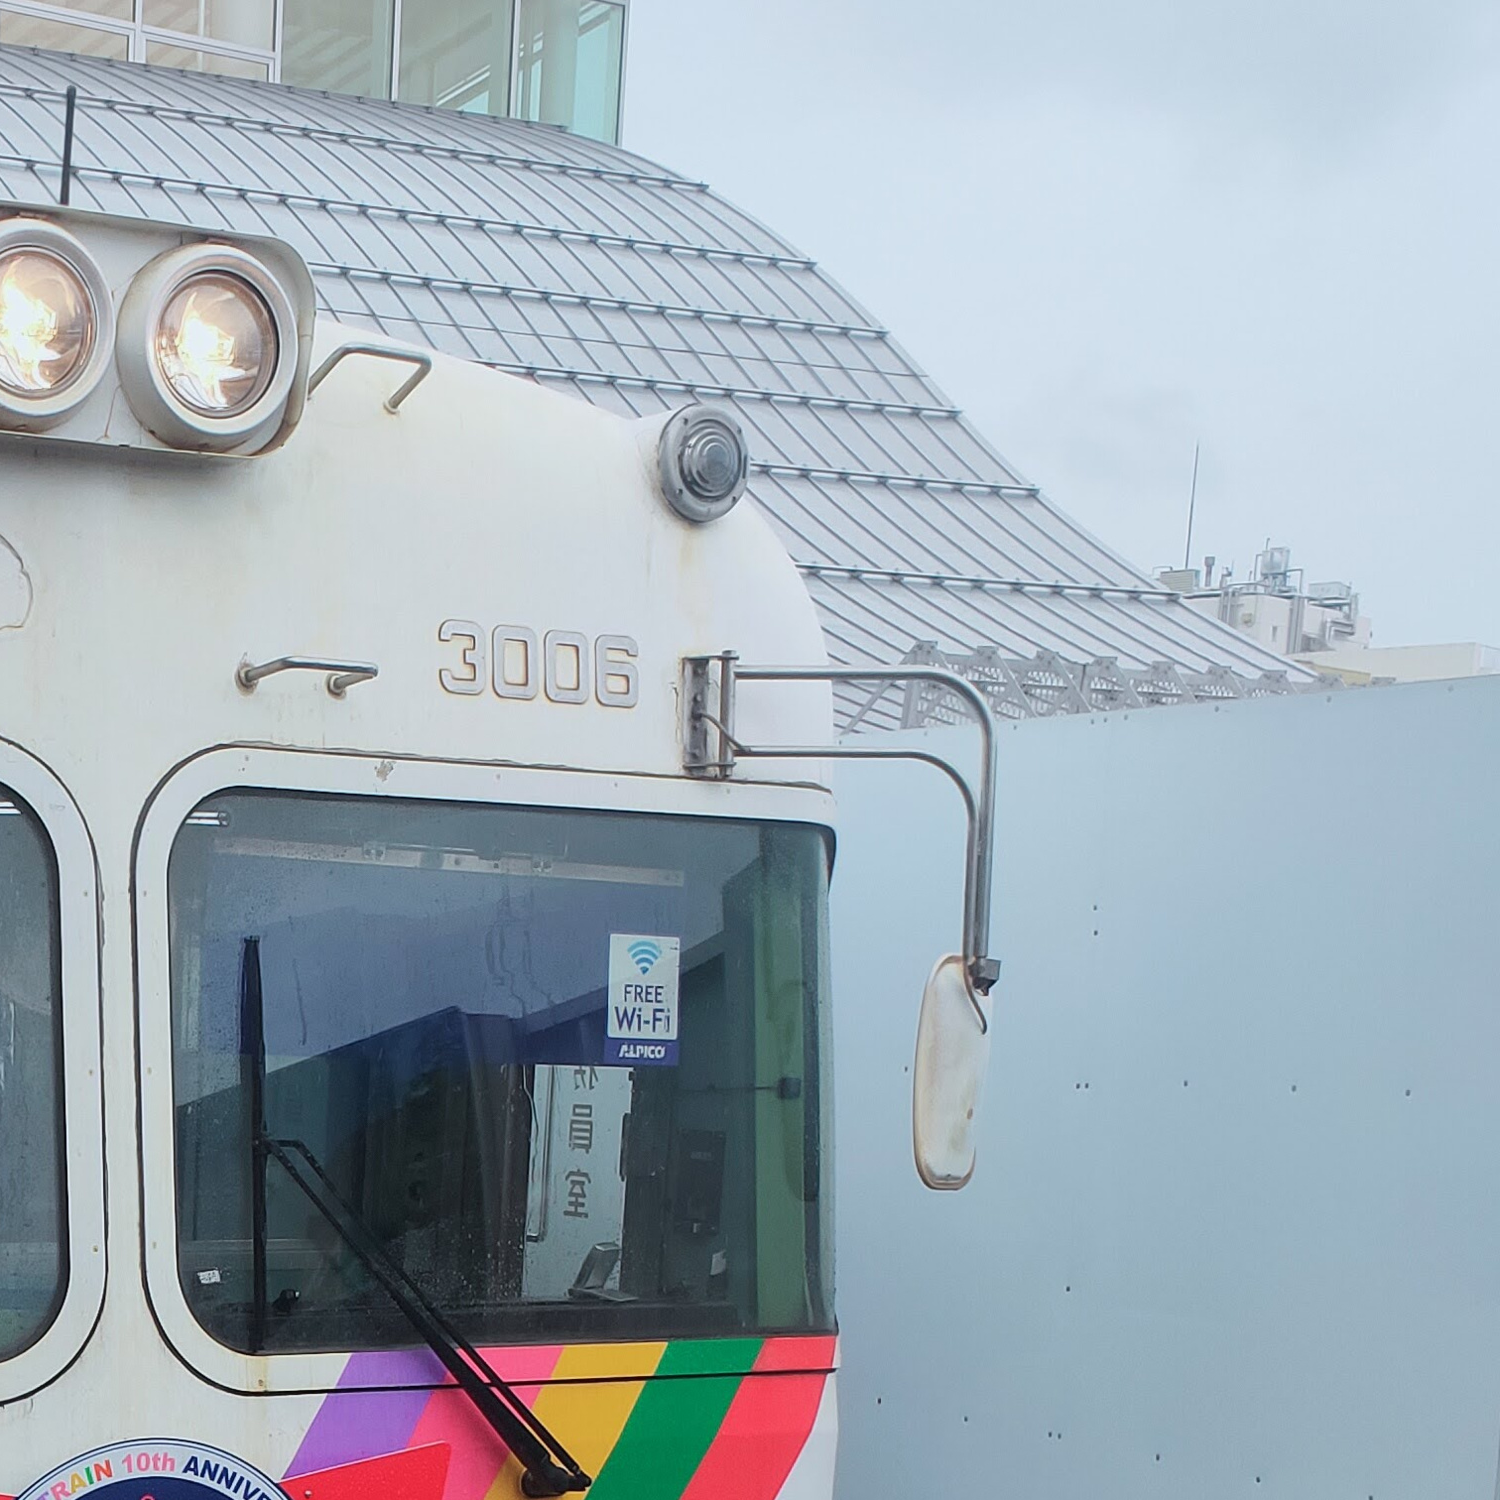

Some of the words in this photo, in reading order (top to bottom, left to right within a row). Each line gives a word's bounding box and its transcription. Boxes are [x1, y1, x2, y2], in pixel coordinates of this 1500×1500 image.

[437, 618, 639, 709] 3006
[623, 983, 665, 1004] FREE
[613, 1005, 672, 1034] Wi-Fi
[121, 1451, 176, 1475] 10th
